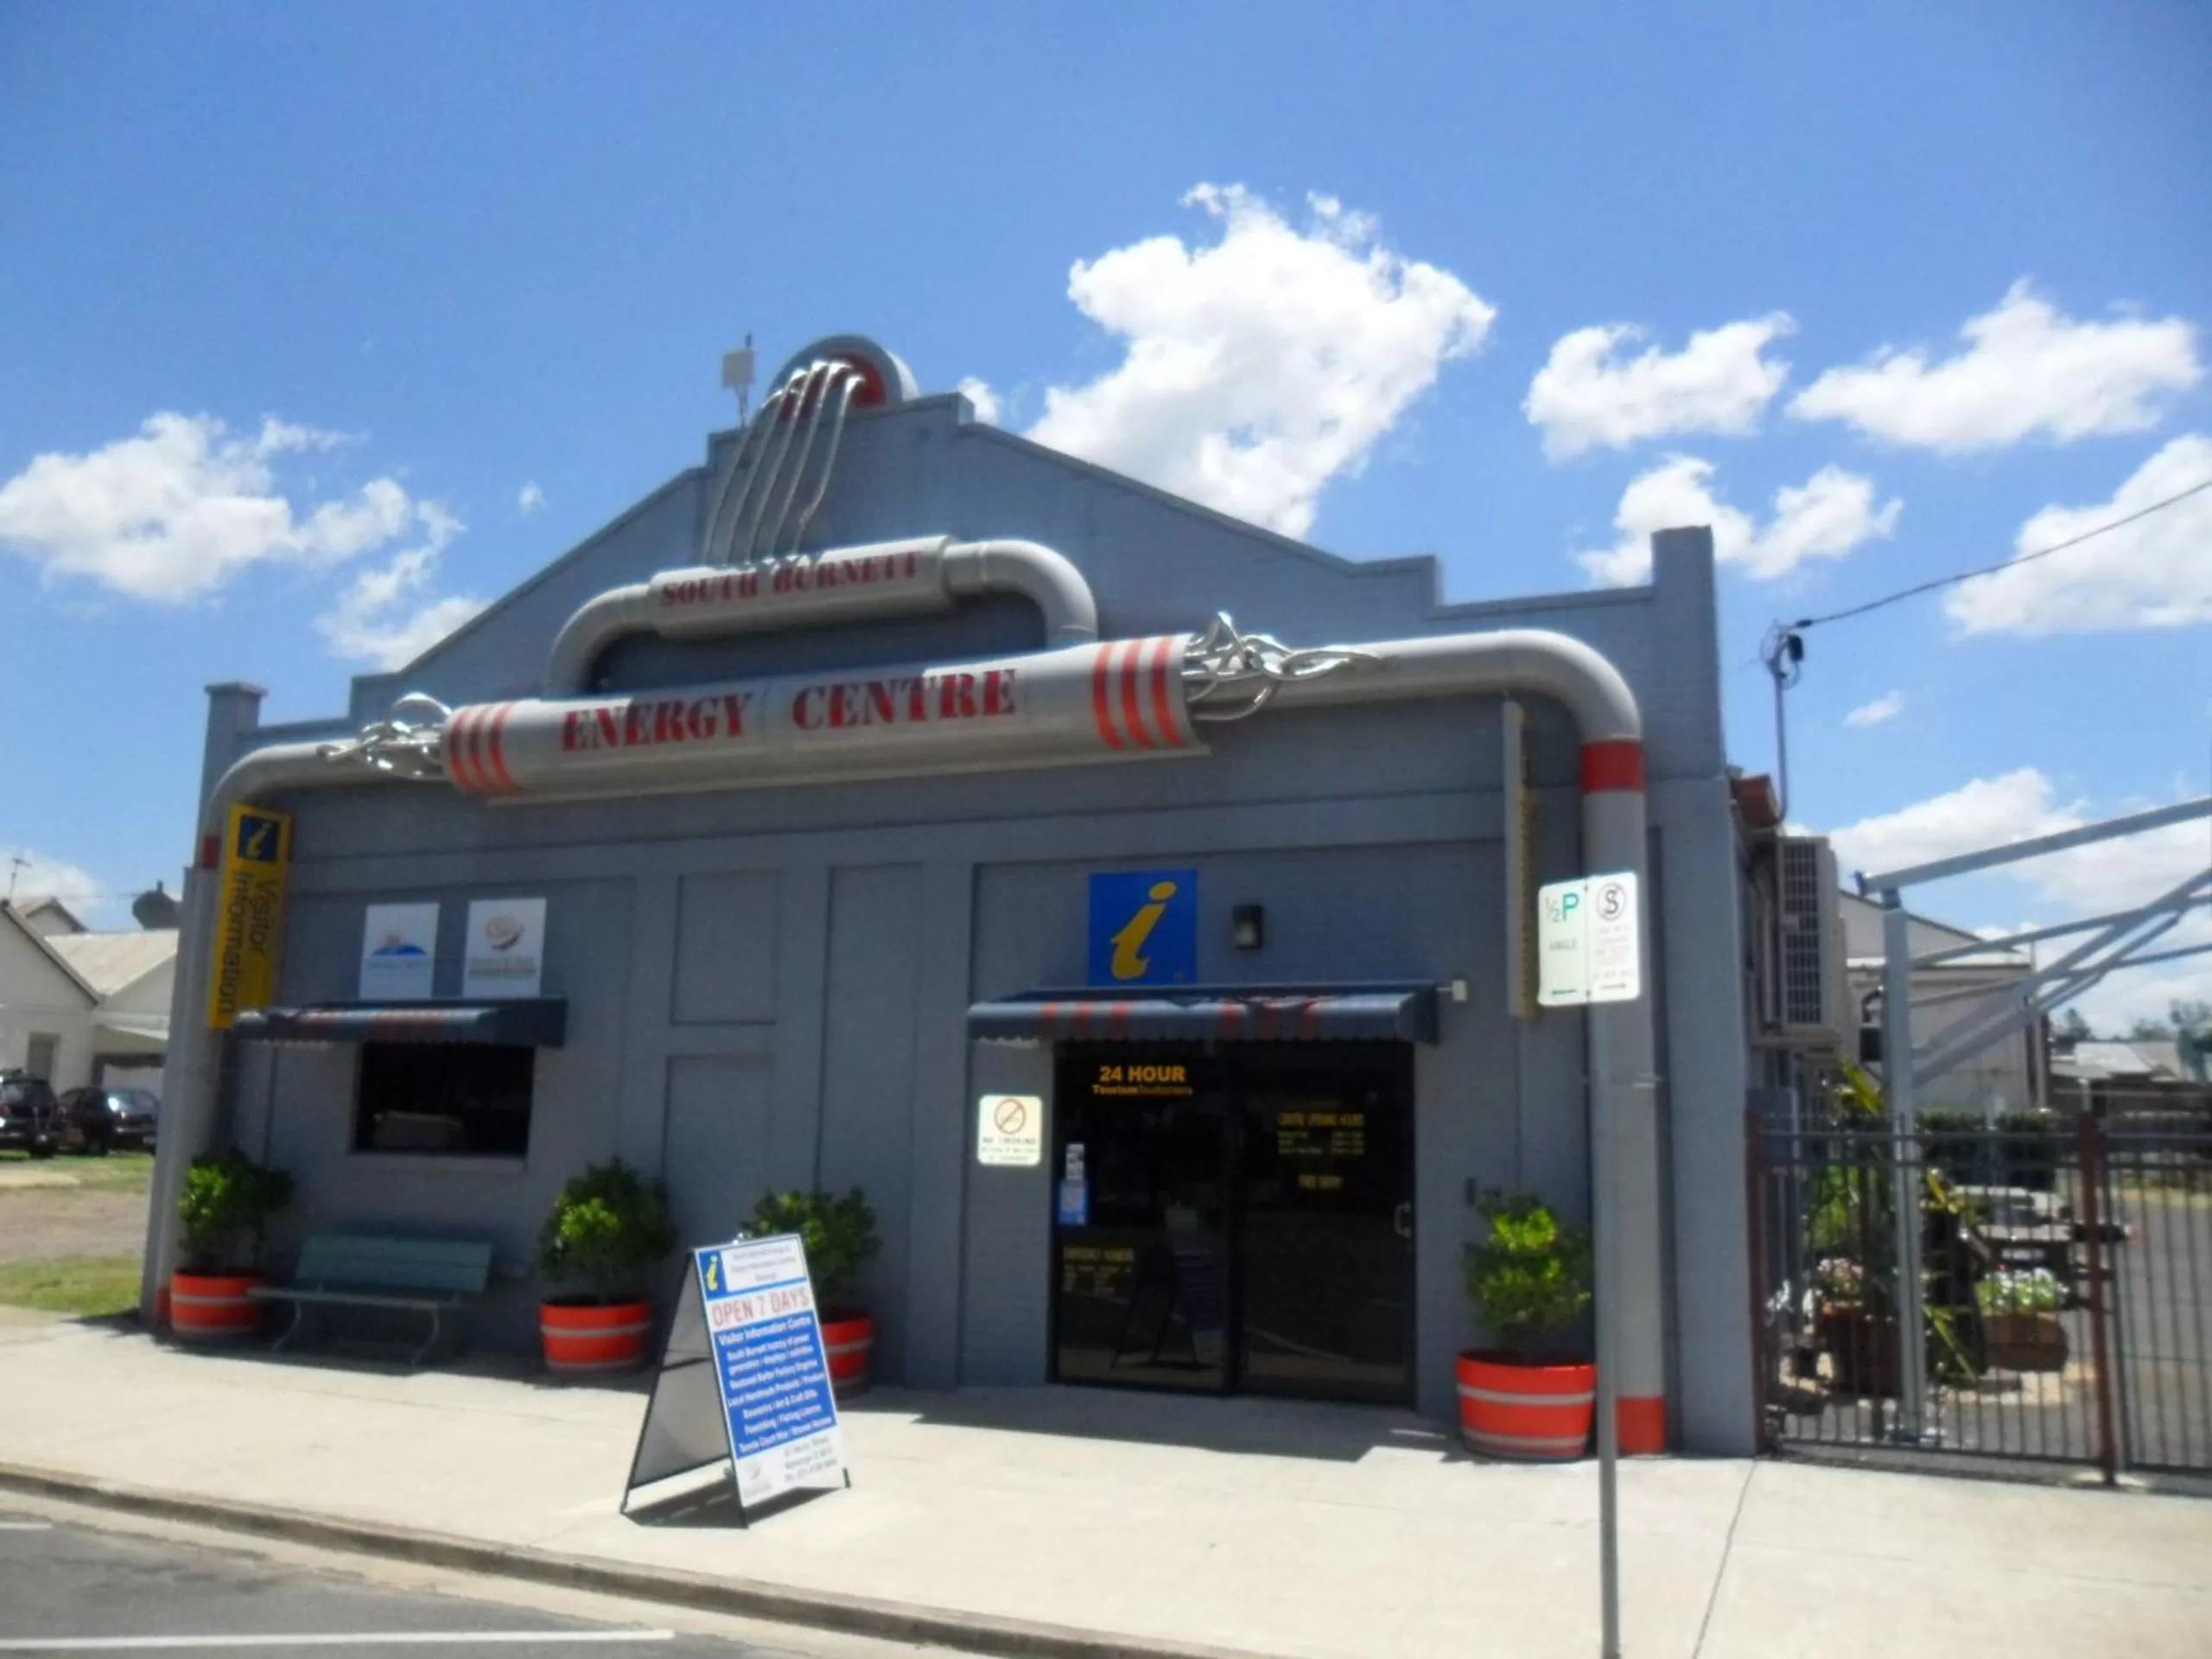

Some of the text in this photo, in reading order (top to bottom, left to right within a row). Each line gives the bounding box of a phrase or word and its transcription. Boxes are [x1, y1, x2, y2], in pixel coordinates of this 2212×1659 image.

[661, 550, 922, 606] SOUTH BURNETT
[561, 668, 1017, 752] ENERGY CENTRE
[218, 871, 256, 1014] Information
[247, 877, 281, 959] Visitor
[1099, 1065, 1185, 1083] 24 HOUR
[712, 1287, 810, 1326] OPEN 7 DAYS
